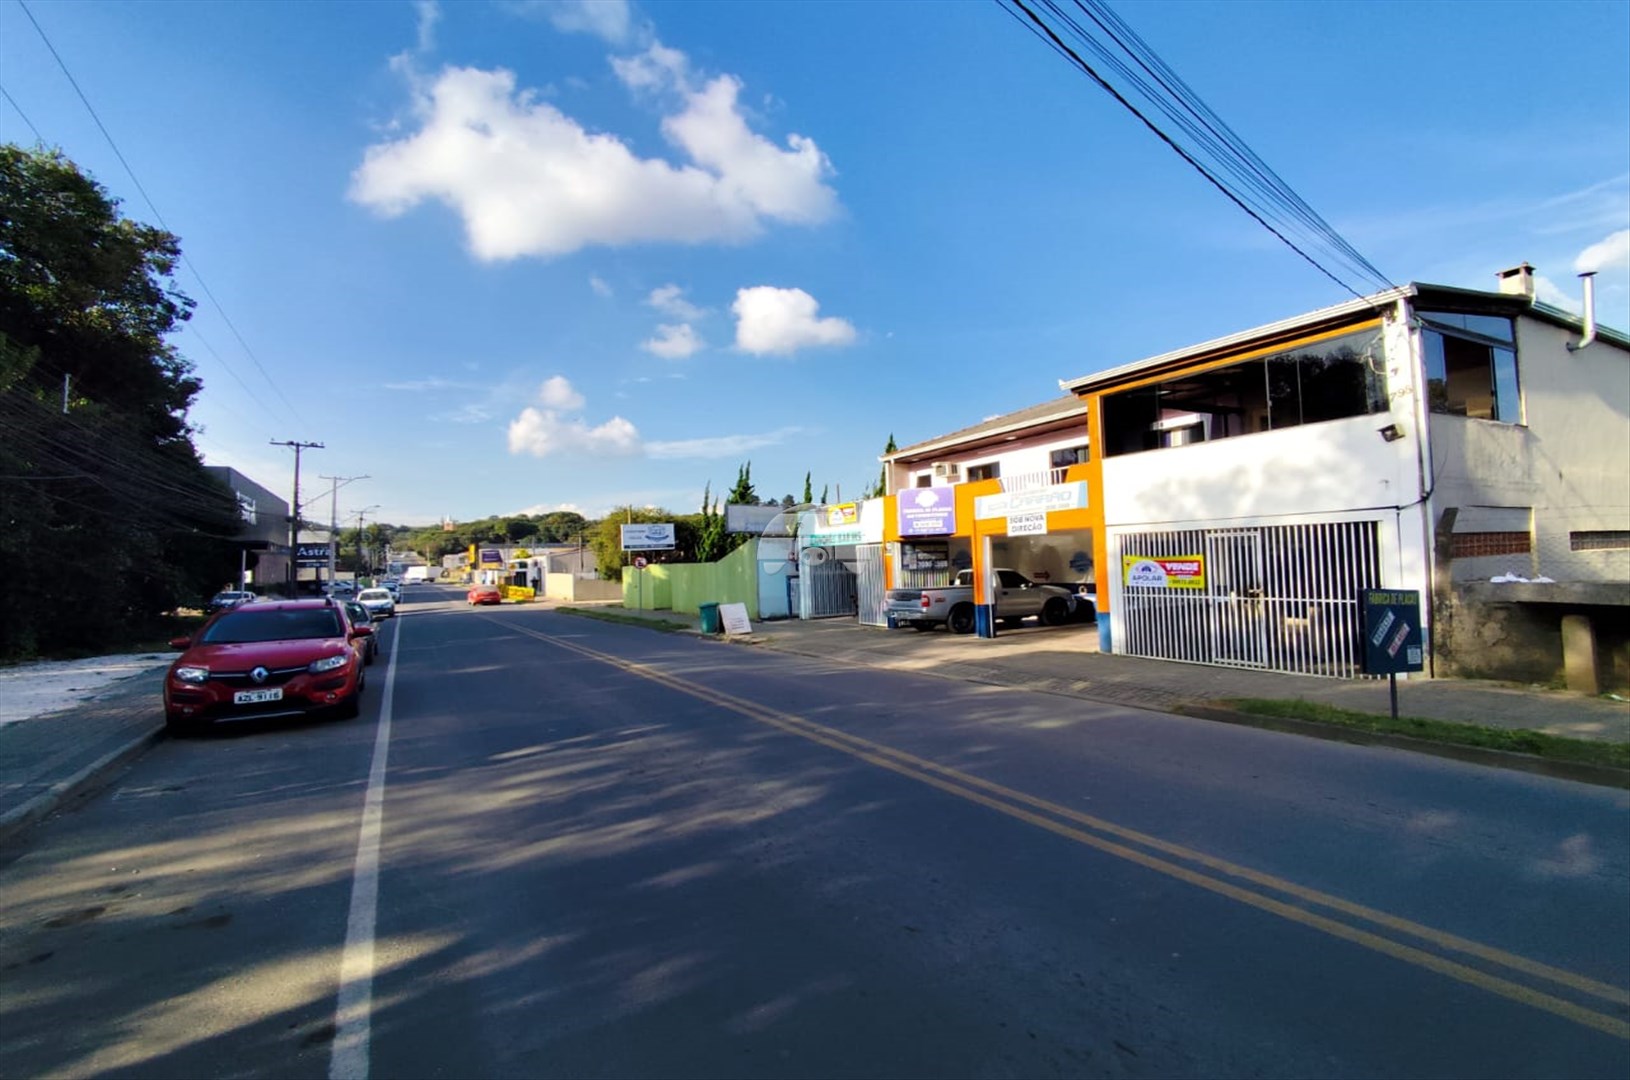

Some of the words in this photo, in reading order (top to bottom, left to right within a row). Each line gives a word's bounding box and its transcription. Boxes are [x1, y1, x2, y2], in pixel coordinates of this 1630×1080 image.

[1009, 516, 1024, 524] SOB
[1024, 514, 1044, 523] NOVA
[1165, 562, 1199, 571] VENDE
